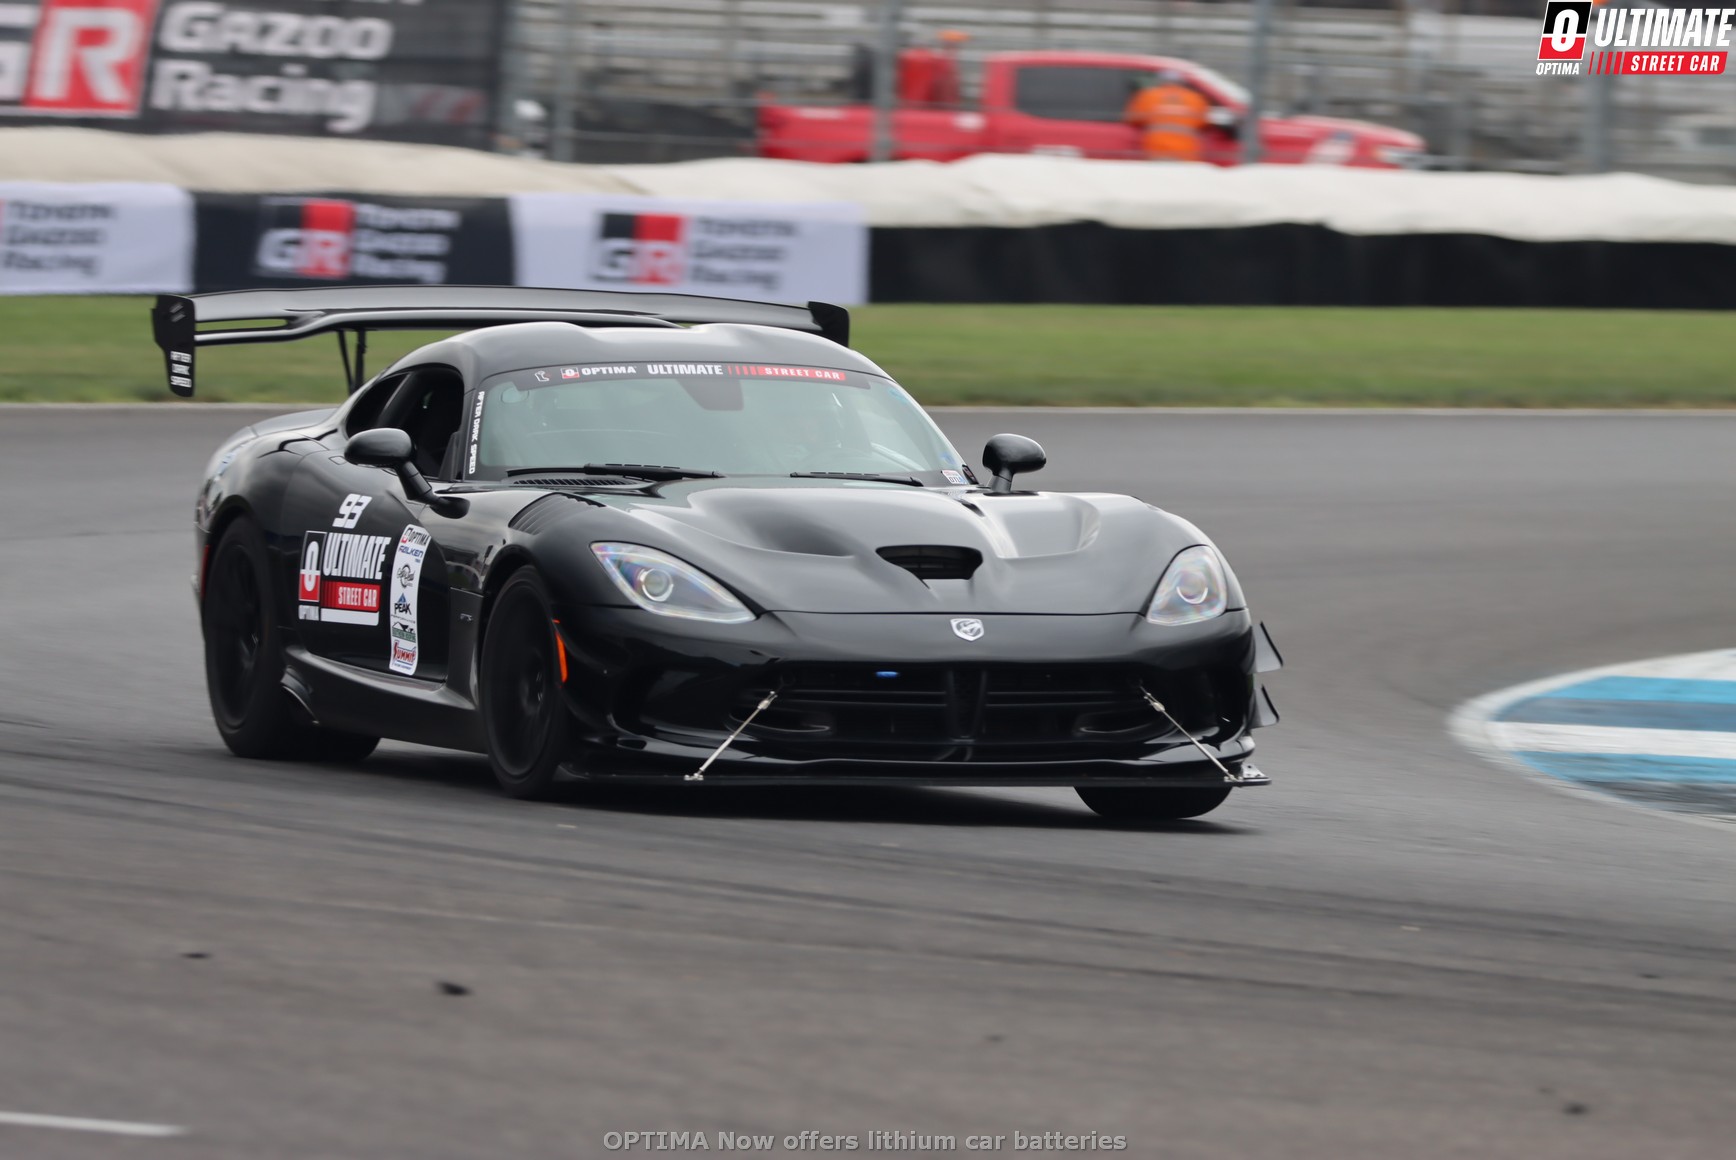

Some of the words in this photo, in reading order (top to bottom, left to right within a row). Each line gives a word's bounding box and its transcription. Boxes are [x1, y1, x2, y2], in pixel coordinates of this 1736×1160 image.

[159, 4, 392, 60] GAZOO
[151, 60, 376, 133] Racing
[257, 228, 349, 275] GR
[581, 365, 637, 376] OPTIMA
[647, 364, 724, 376] ULTIMATE
[764, 367, 810, 377] STREET
[815, 370, 841, 380] CAR
[474, 391, 485, 418] AFTER
[471, 417, 481, 442] DARK
[468, 443, 477, 475] SPEED
[332, 493, 373, 529] 93
[322, 532, 392, 580] ULTIMATE
[338, 586, 362, 606] STREET
[363, 588, 377, 607] CAR
[394, 603, 412, 615] PEAK
[394, 642, 416, 662] SUMMIT
